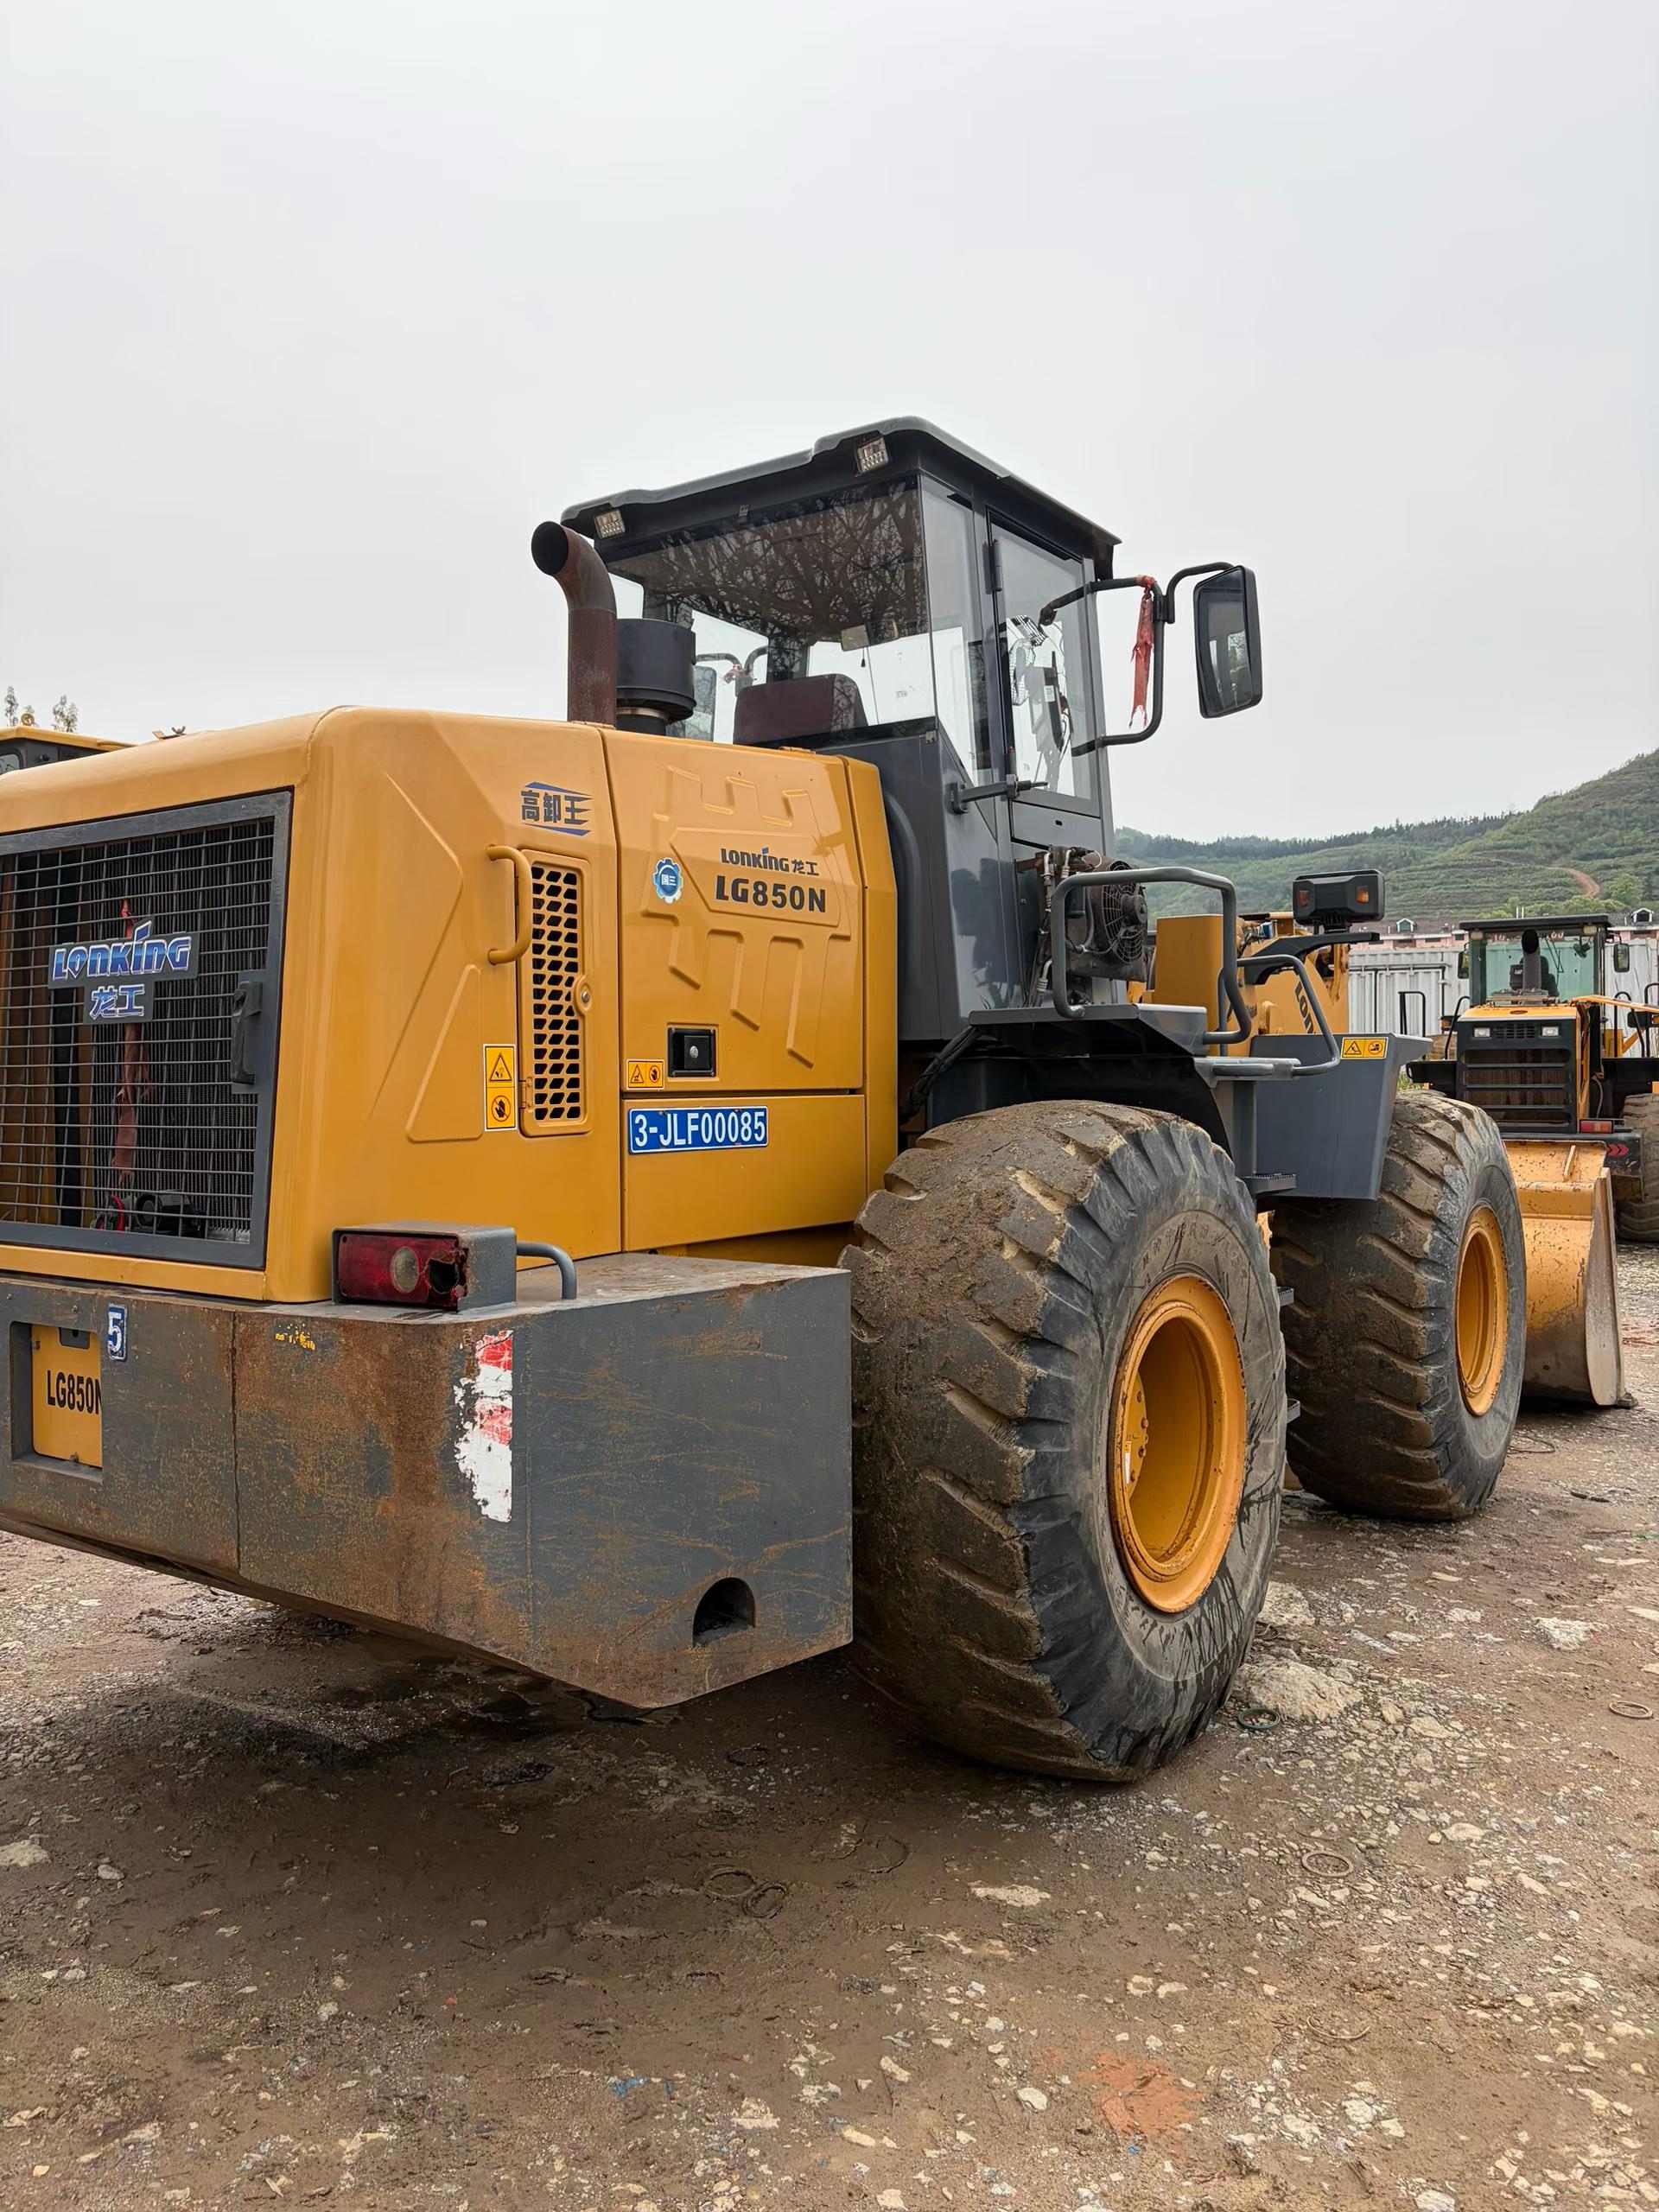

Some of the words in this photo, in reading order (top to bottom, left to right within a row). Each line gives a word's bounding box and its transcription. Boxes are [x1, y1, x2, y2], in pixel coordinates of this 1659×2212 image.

[520, 789, 594, 825] 高卸王
[791, 859, 820, 877] 龙工
[715, 874, 826, 913] LG850N
[89, 983, 145, 1020] 龙工
[634, 1111, 766, 1147] 3-JLF00085
[107, 1311, 122, 1353] 5
